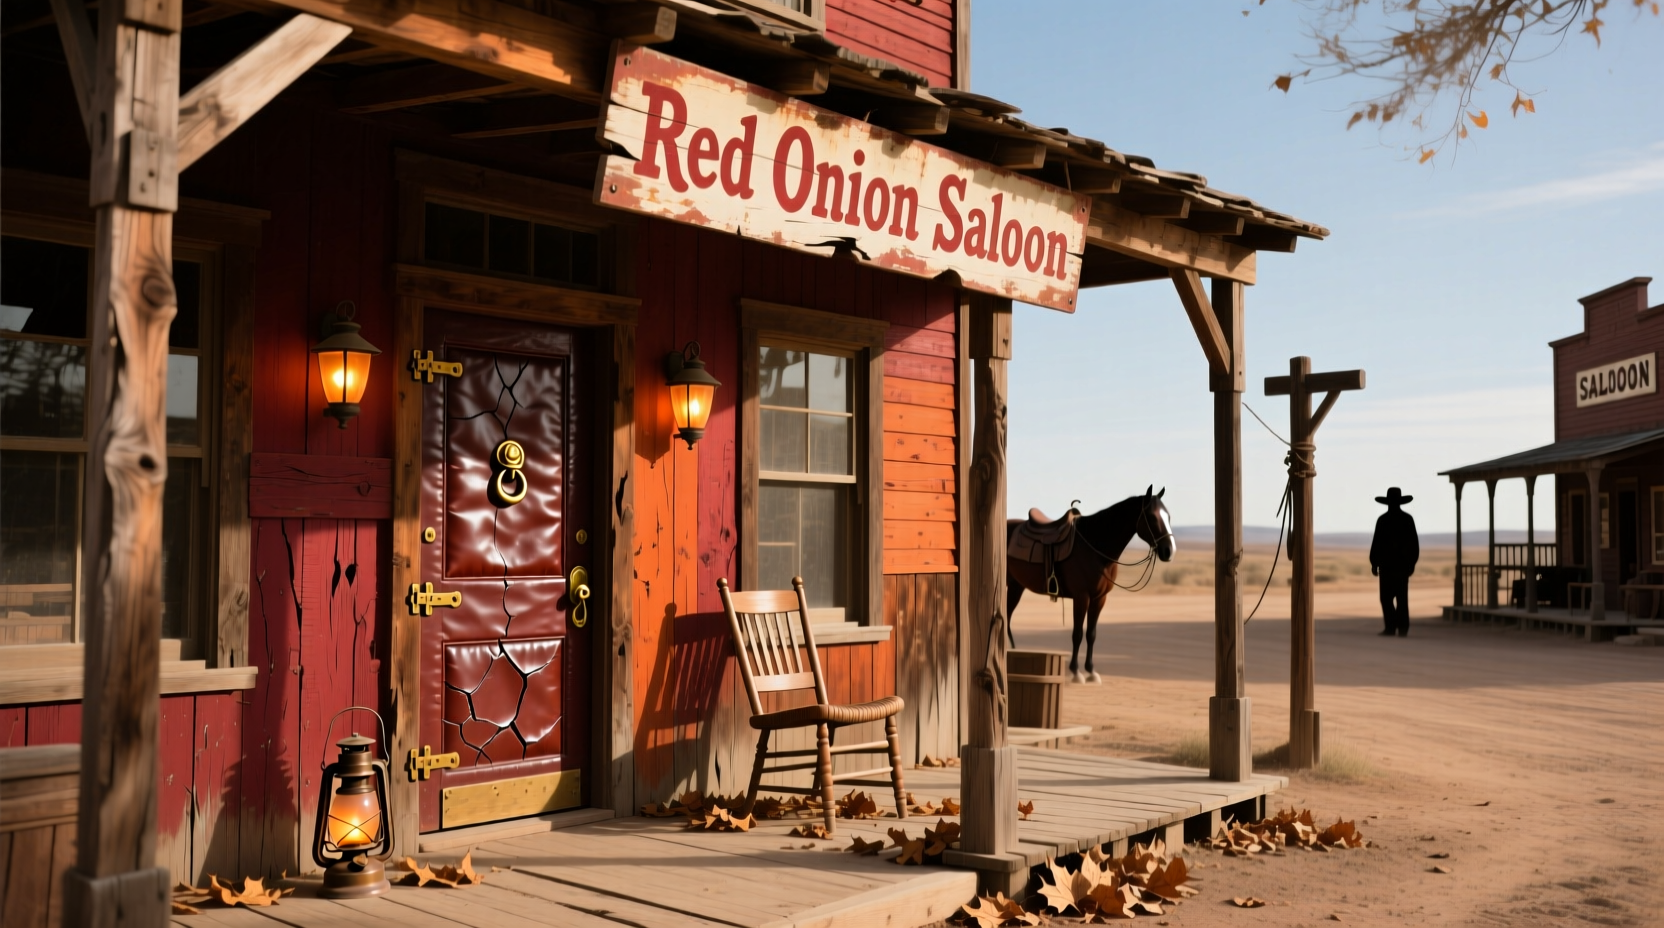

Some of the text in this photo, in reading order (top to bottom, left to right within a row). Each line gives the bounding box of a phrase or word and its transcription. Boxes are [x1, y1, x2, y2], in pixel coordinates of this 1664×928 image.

[634, 81, 1068, 281] Red Onion Saloon
